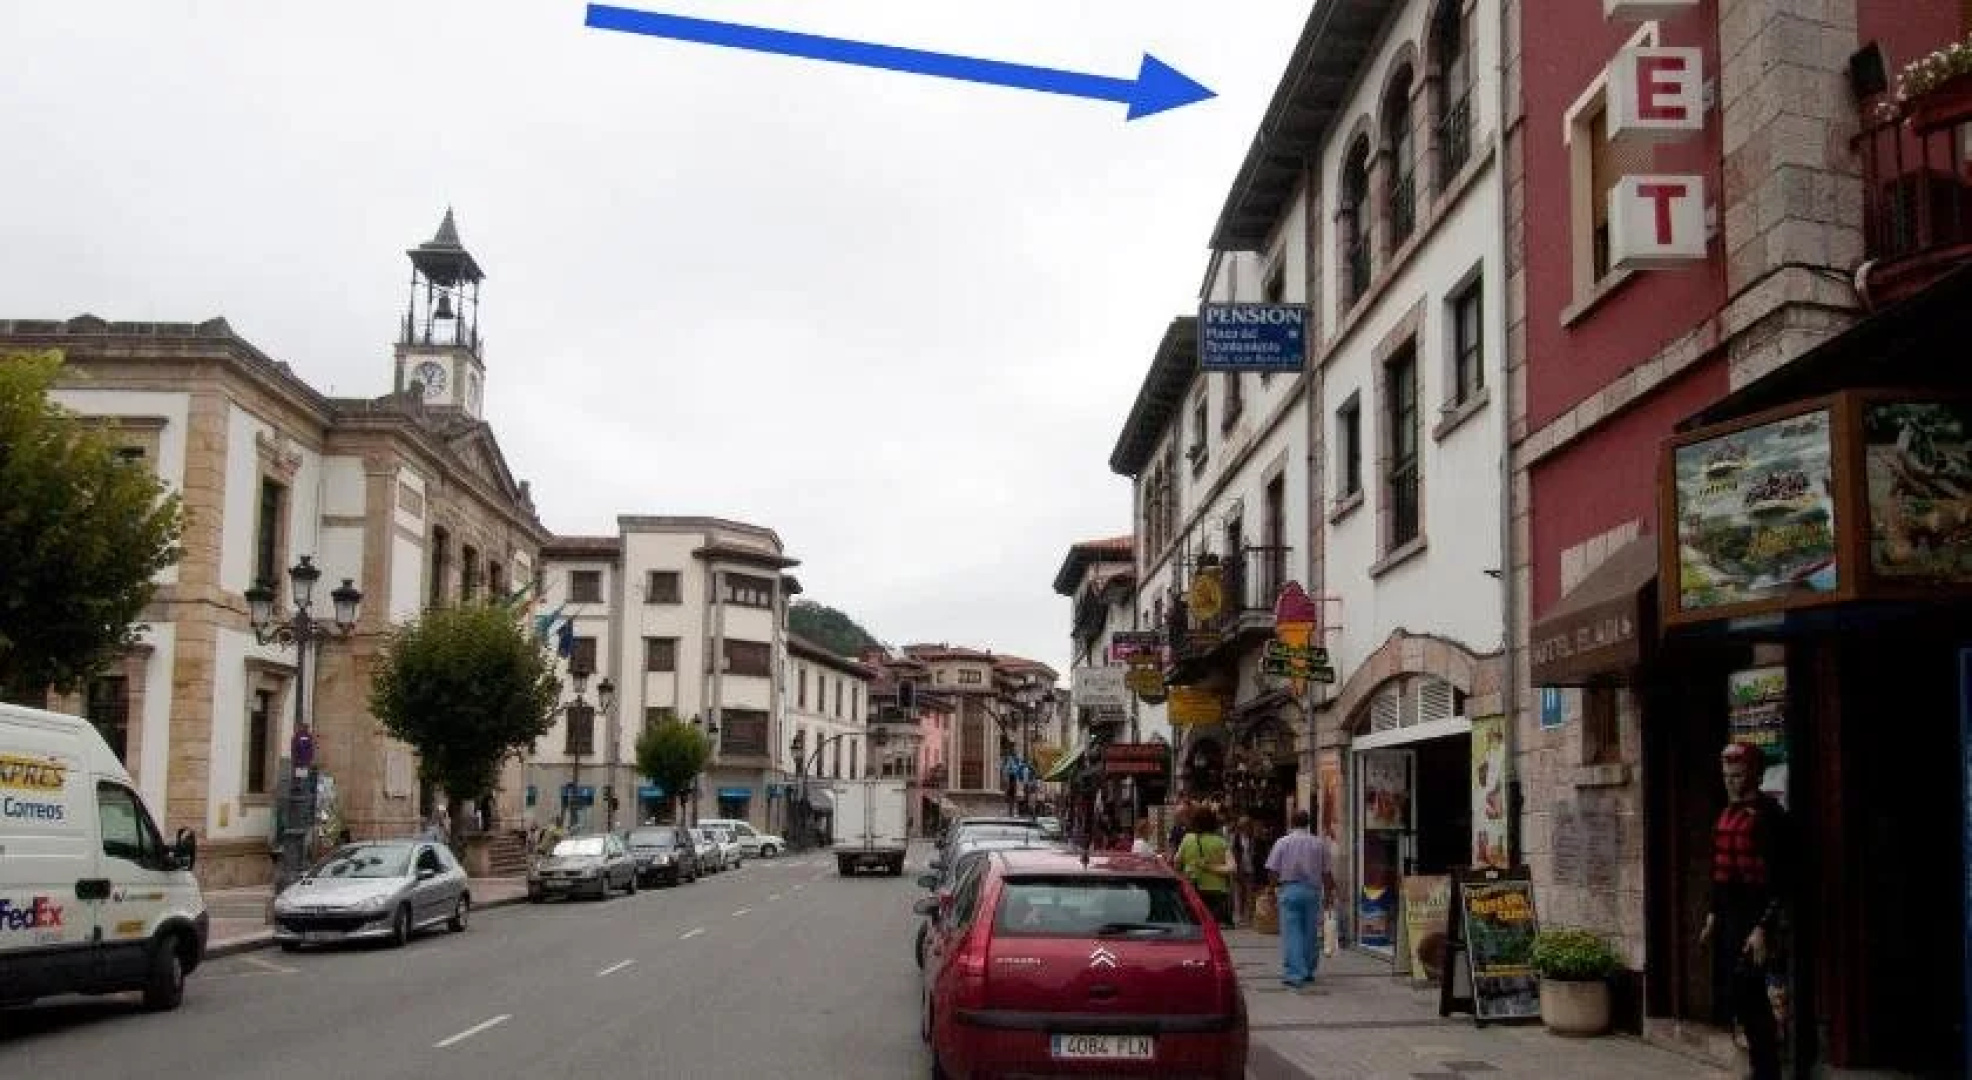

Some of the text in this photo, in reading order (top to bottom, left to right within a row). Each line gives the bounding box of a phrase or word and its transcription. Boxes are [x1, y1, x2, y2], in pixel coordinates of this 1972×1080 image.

[1204, 306, 1302, 325] PENSION
[4, 796, 64, 819] Correos
[0, 896, 63, 929] FedEx
[1068, 1035, 1149, 1055] 4084 FLN
